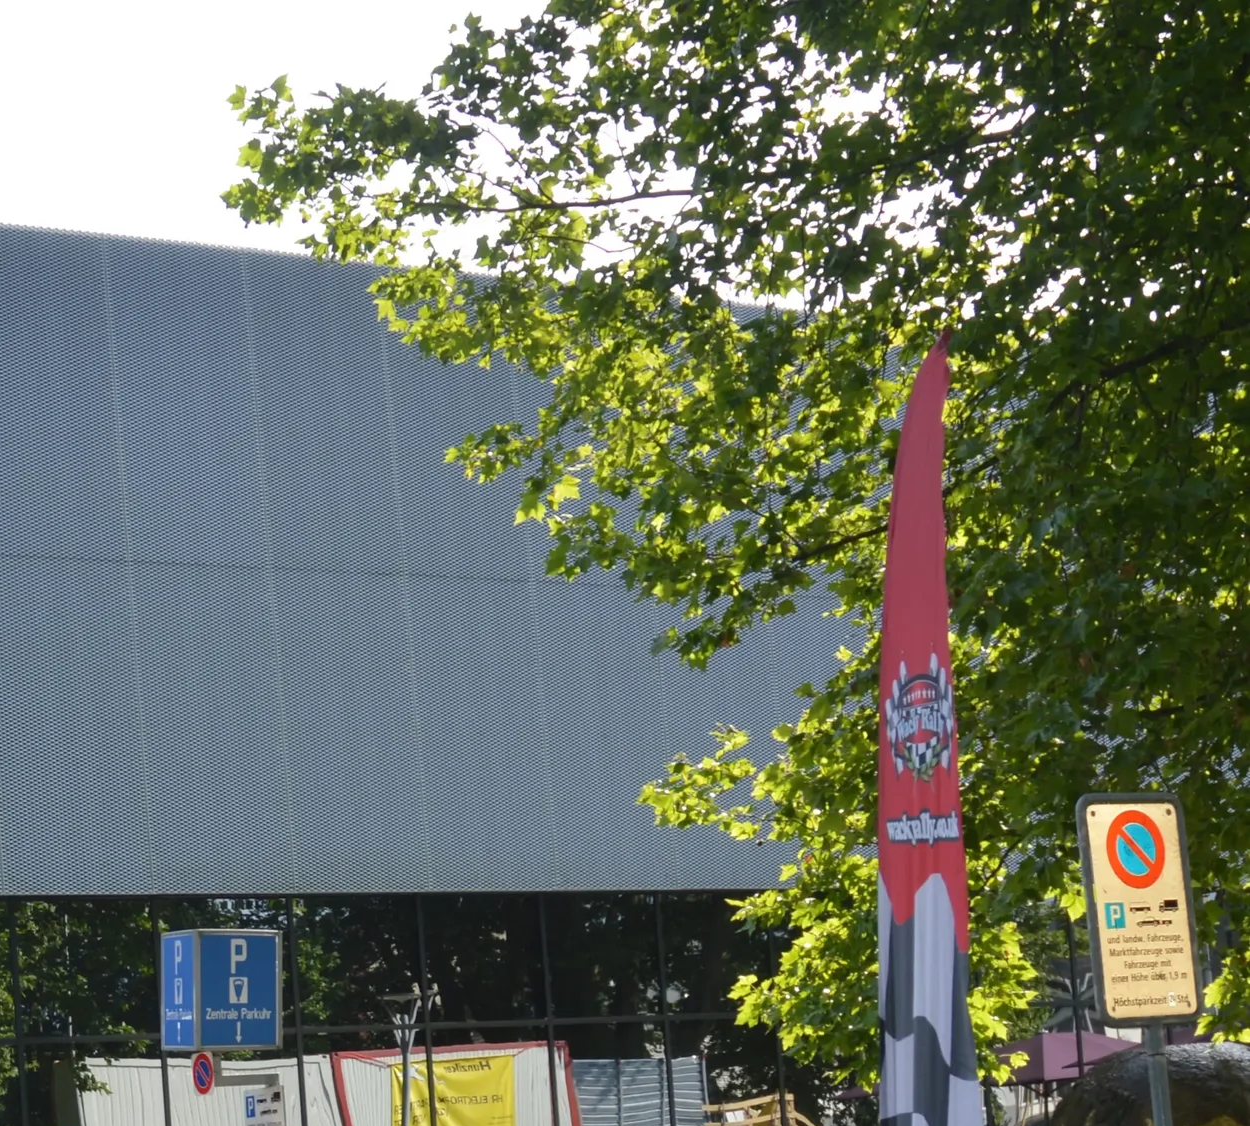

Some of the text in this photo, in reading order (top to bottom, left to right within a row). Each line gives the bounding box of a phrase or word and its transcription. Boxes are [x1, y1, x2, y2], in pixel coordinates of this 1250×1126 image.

[1111, 905, 1121, 926] P
[1107, 935, 1120, 944] und
[174, 940, 182, 975] P
[231, 939, 247, 974] P
[1109, 946, 1184, 957] Marktfahrzeuge sowie
[1124, 959, 1171, 970] Fahrzeuge mit
[1111, 974, 1128, 983] einer
[1131, 973, 1149, 982] Höhe
[1169, 971, 1179, 980] 1,9
[1113, 995, 1167, 1008] Höchstparkzeit
[206, 1008, 238, 1020] Zentrale
[241, 1008, 272, 1020] Parkuhr
